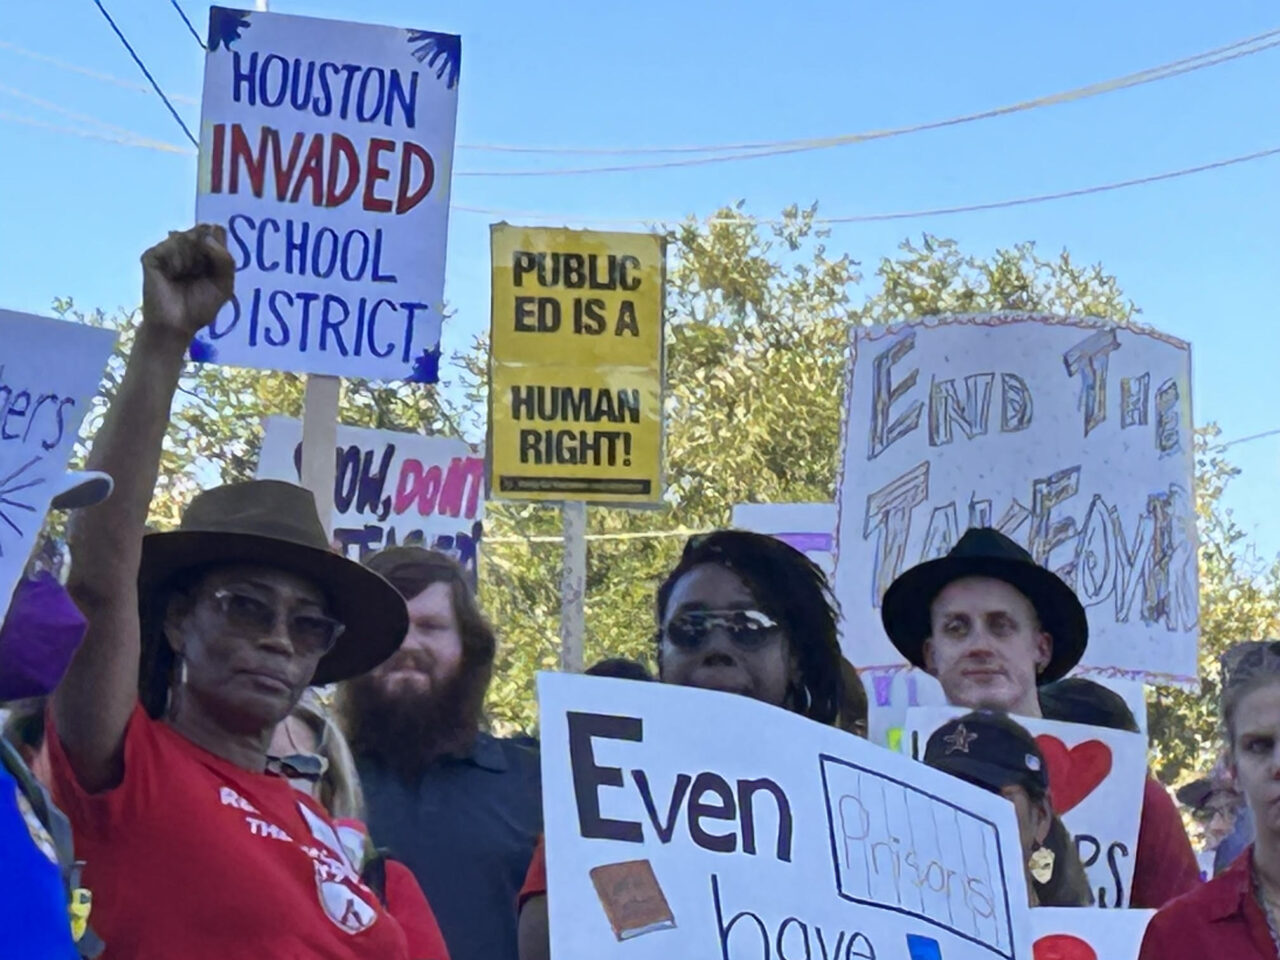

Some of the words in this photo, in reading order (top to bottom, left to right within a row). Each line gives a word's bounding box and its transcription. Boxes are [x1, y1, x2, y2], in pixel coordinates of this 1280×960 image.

[233, 51, 419, 128] HOUSTON
[211, 123, 435, 215] INVADED
[228, 214, 398, 284] SCHOOL
[513, 250, 642, 292] PUBLIC
[514, 296, 562, 333] ED
[573, 297, 607, 336] IS
[614, 300, 640, 337] A
[511, 385, 640, 424] HUMAN
[868, 331, 1033, 461] END
[1063, 328, 1180, 460] THE
[519, 428, 633, 468] RIGHT!
[863, 460, 1198, 632] TAEOVER
[566, 711, 792, 863] Even
[838, 793, 998, 920] Prisons
